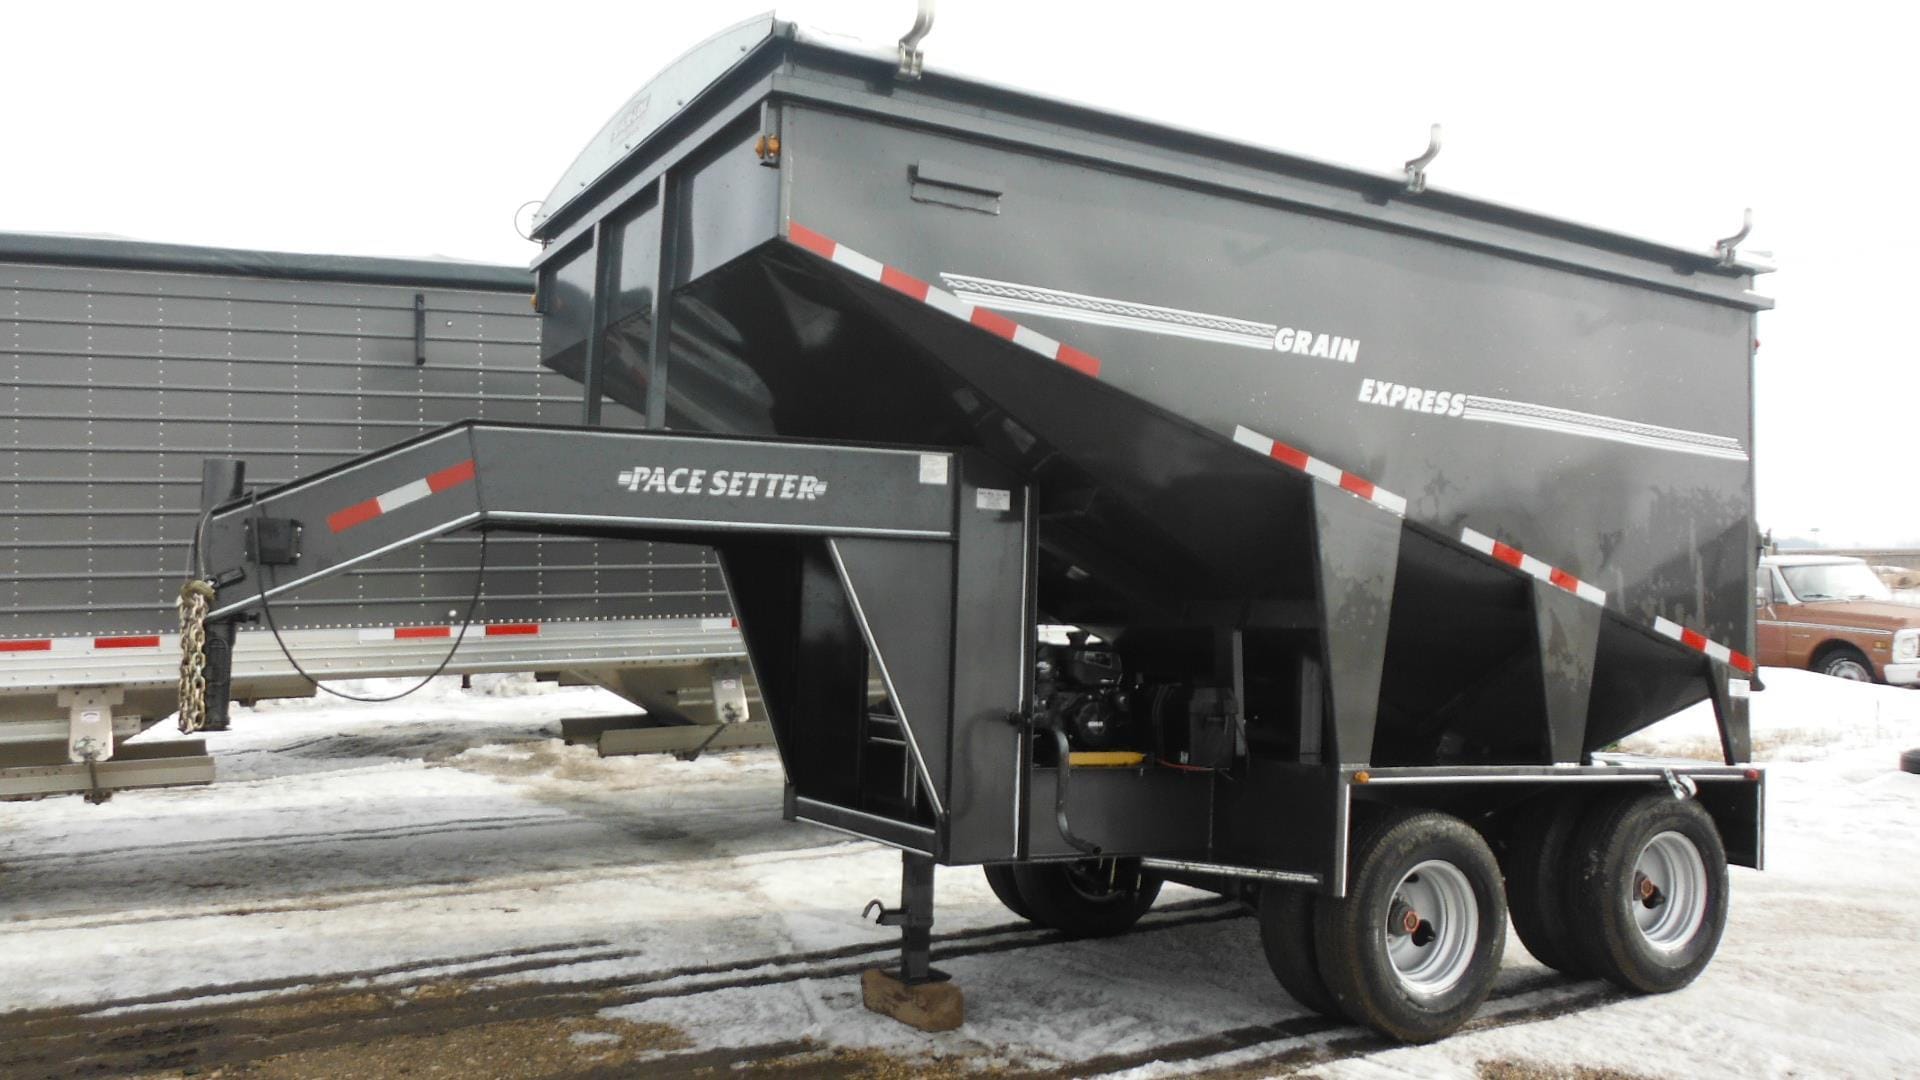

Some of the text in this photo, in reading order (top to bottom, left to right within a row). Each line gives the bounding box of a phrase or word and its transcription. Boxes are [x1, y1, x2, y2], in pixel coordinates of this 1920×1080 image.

[1274, 327, 1360, 363] GRAIN
[1358, 378, 1466, 417] EXPRESS
[628, 466, 818, 500] PACE SETTER
